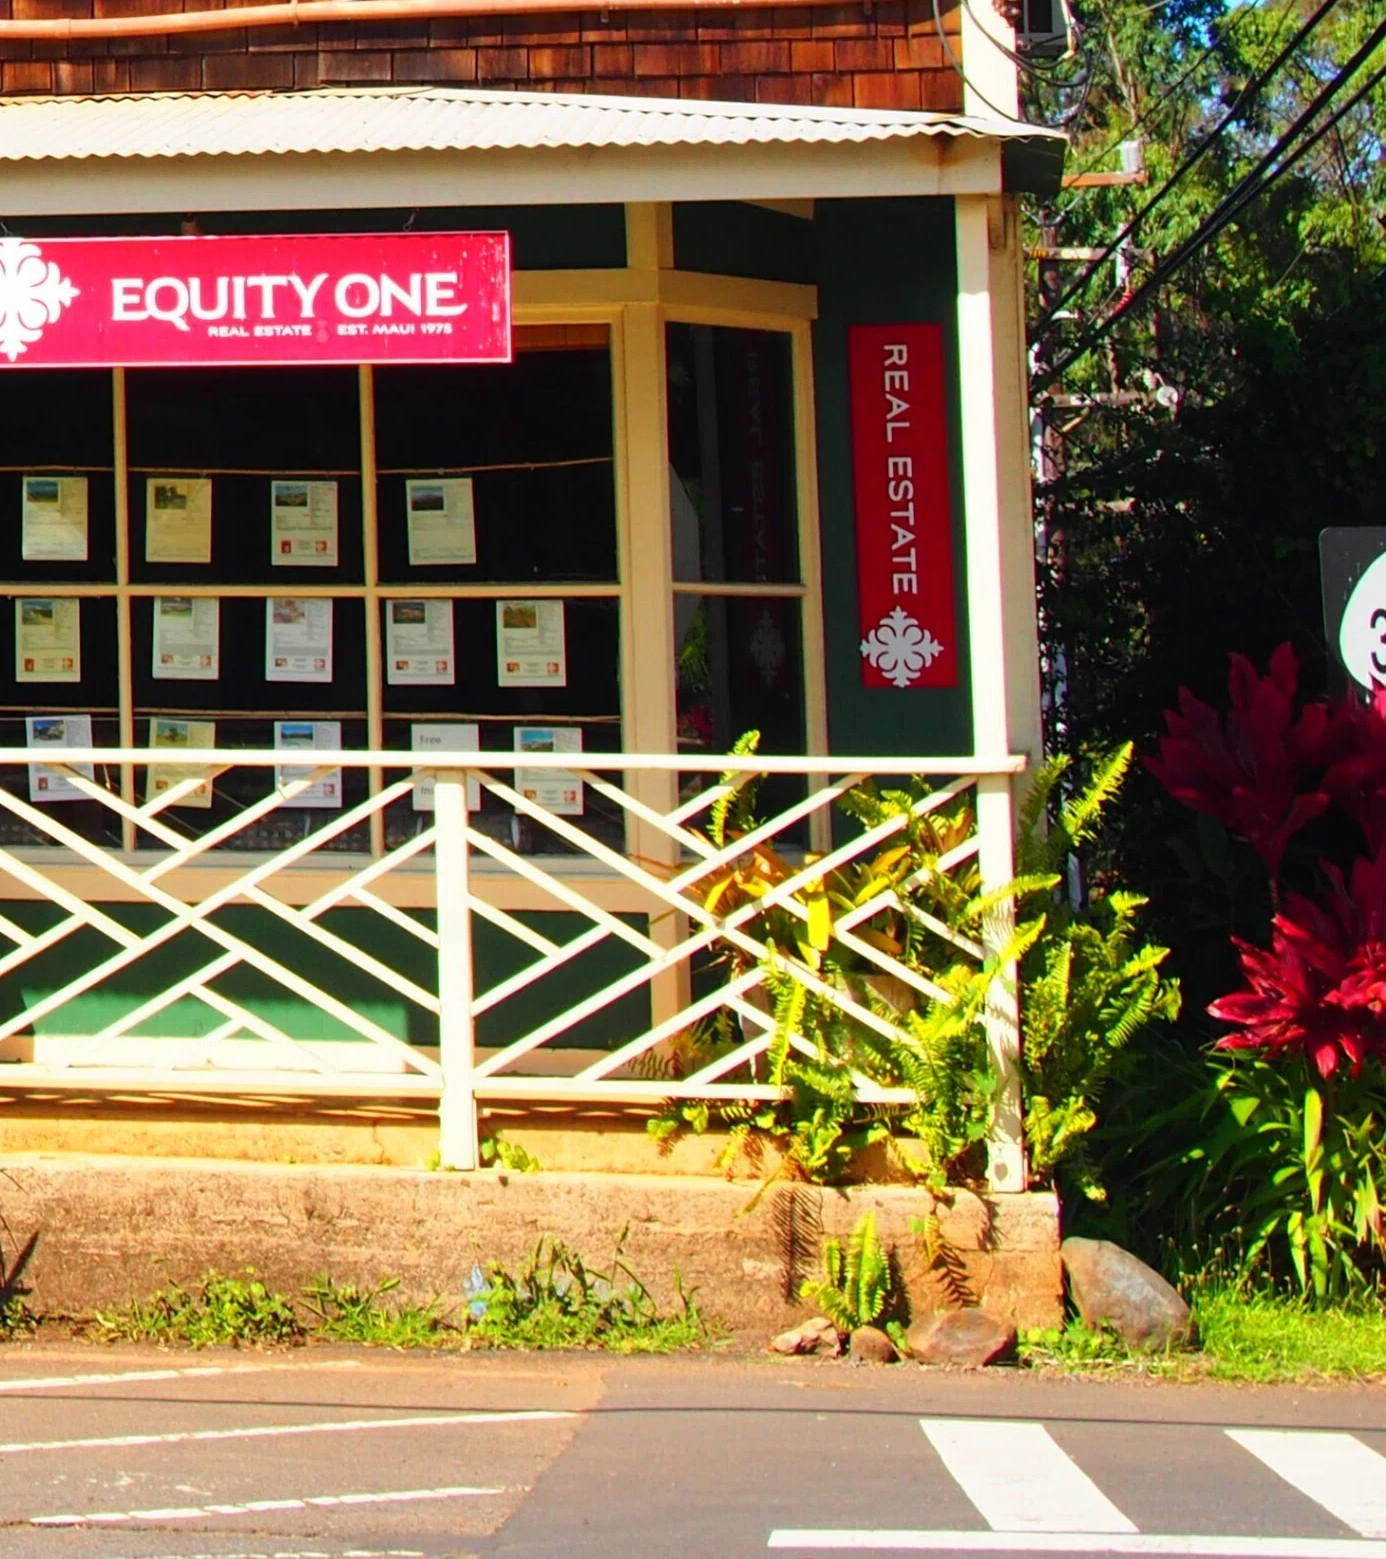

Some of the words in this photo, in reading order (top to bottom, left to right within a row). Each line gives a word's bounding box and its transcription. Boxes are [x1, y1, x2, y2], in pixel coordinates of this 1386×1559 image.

[111, 273, 328, 331] EQUITY
[335, 273, 467, 318] ONE
[208, 325, 249, 338] REAL
[254, 324, 312, 337] ESTATE
[338, 323, 368, 336] EST.
[373, 322, 415, 336] MAUI
[883, 343, 910, 443] REAL
[888, 456, 918, 595] ESTATE
[420, 735, 441, 745] Free
